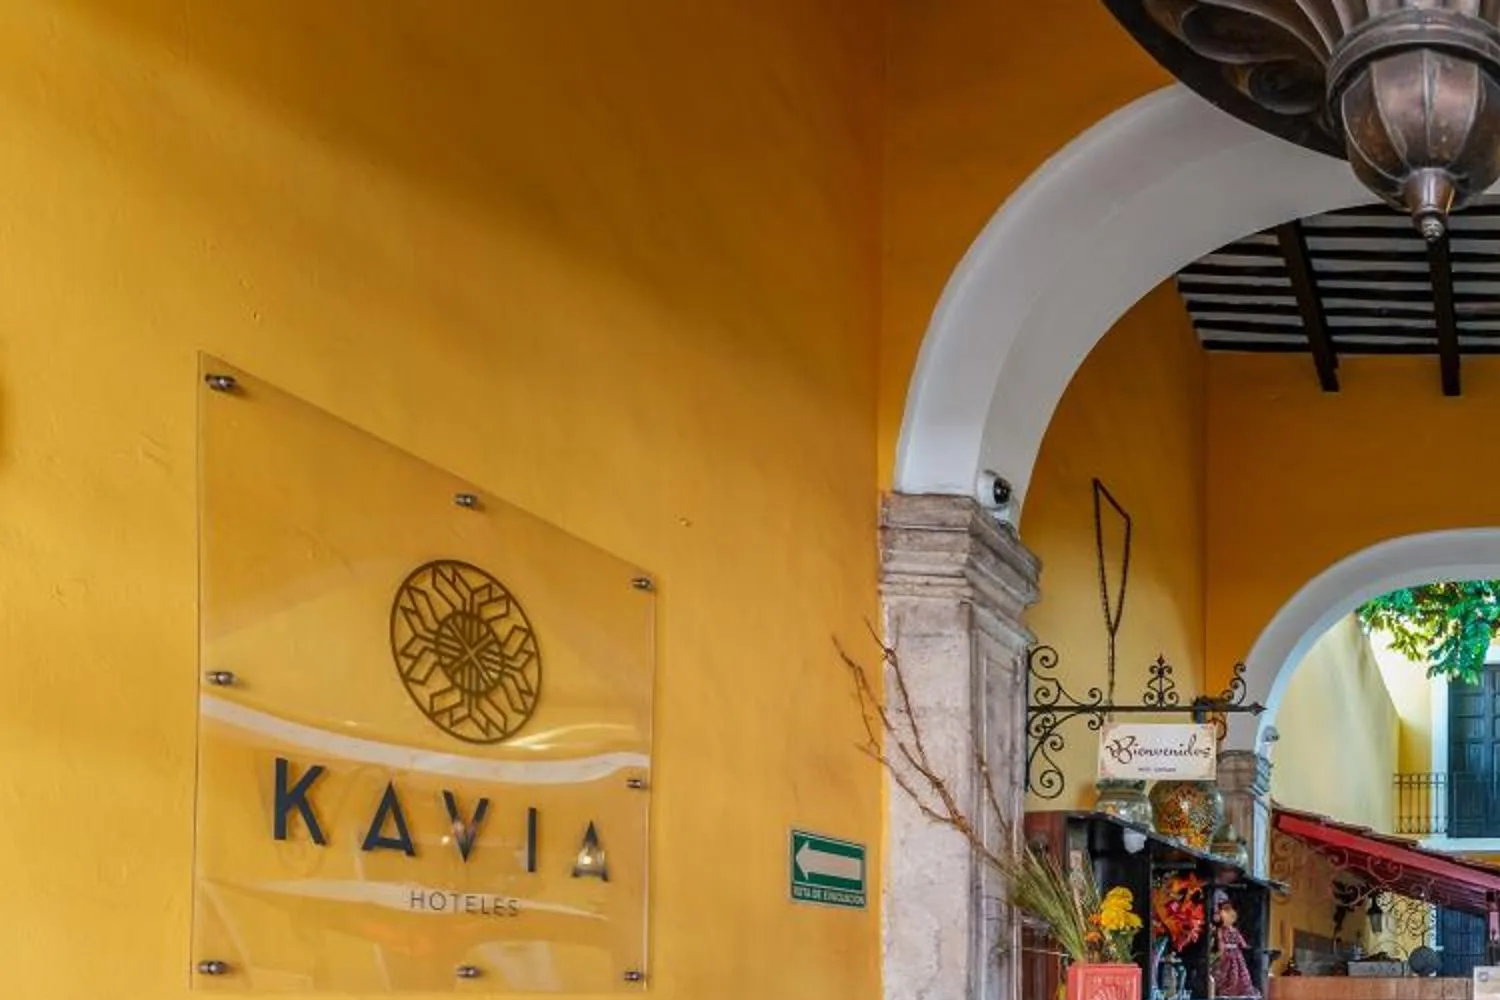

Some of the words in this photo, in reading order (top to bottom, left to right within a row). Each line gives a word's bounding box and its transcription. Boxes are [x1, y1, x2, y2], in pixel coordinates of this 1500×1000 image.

[1105, 733, 1212, 764] Bienvenidos
[273, 757, 610, 883] KAVIA
[409, 890, 520, 918] HOTELES
